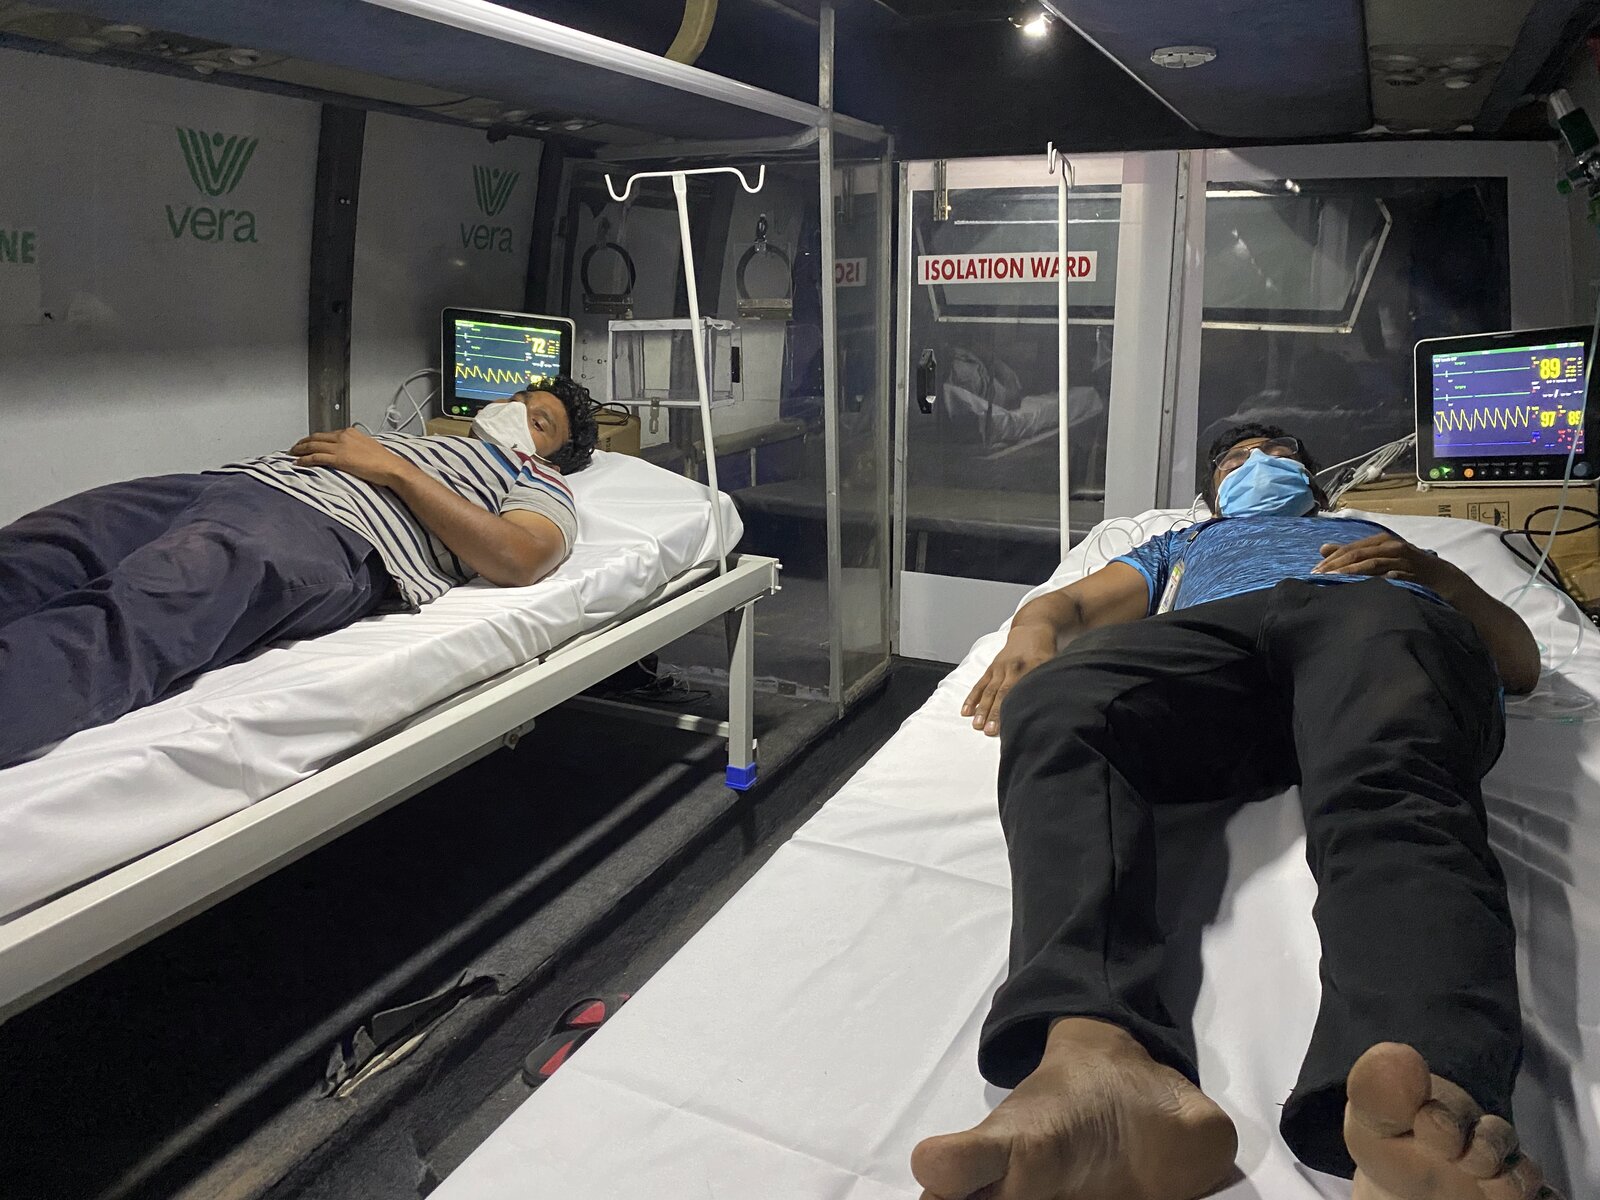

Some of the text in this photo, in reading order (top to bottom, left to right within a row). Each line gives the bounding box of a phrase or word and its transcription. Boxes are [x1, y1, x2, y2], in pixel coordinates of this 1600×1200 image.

[164, 204, 258, 243] vera
[460, 222, 513, 254] vera
[925, 256, 1091, 281] ISOLATION WARD
[531, 337, 546, 354] 72
[1540, 357, 1561, 380] 89
[1540, 410, 1557, 428] 97
